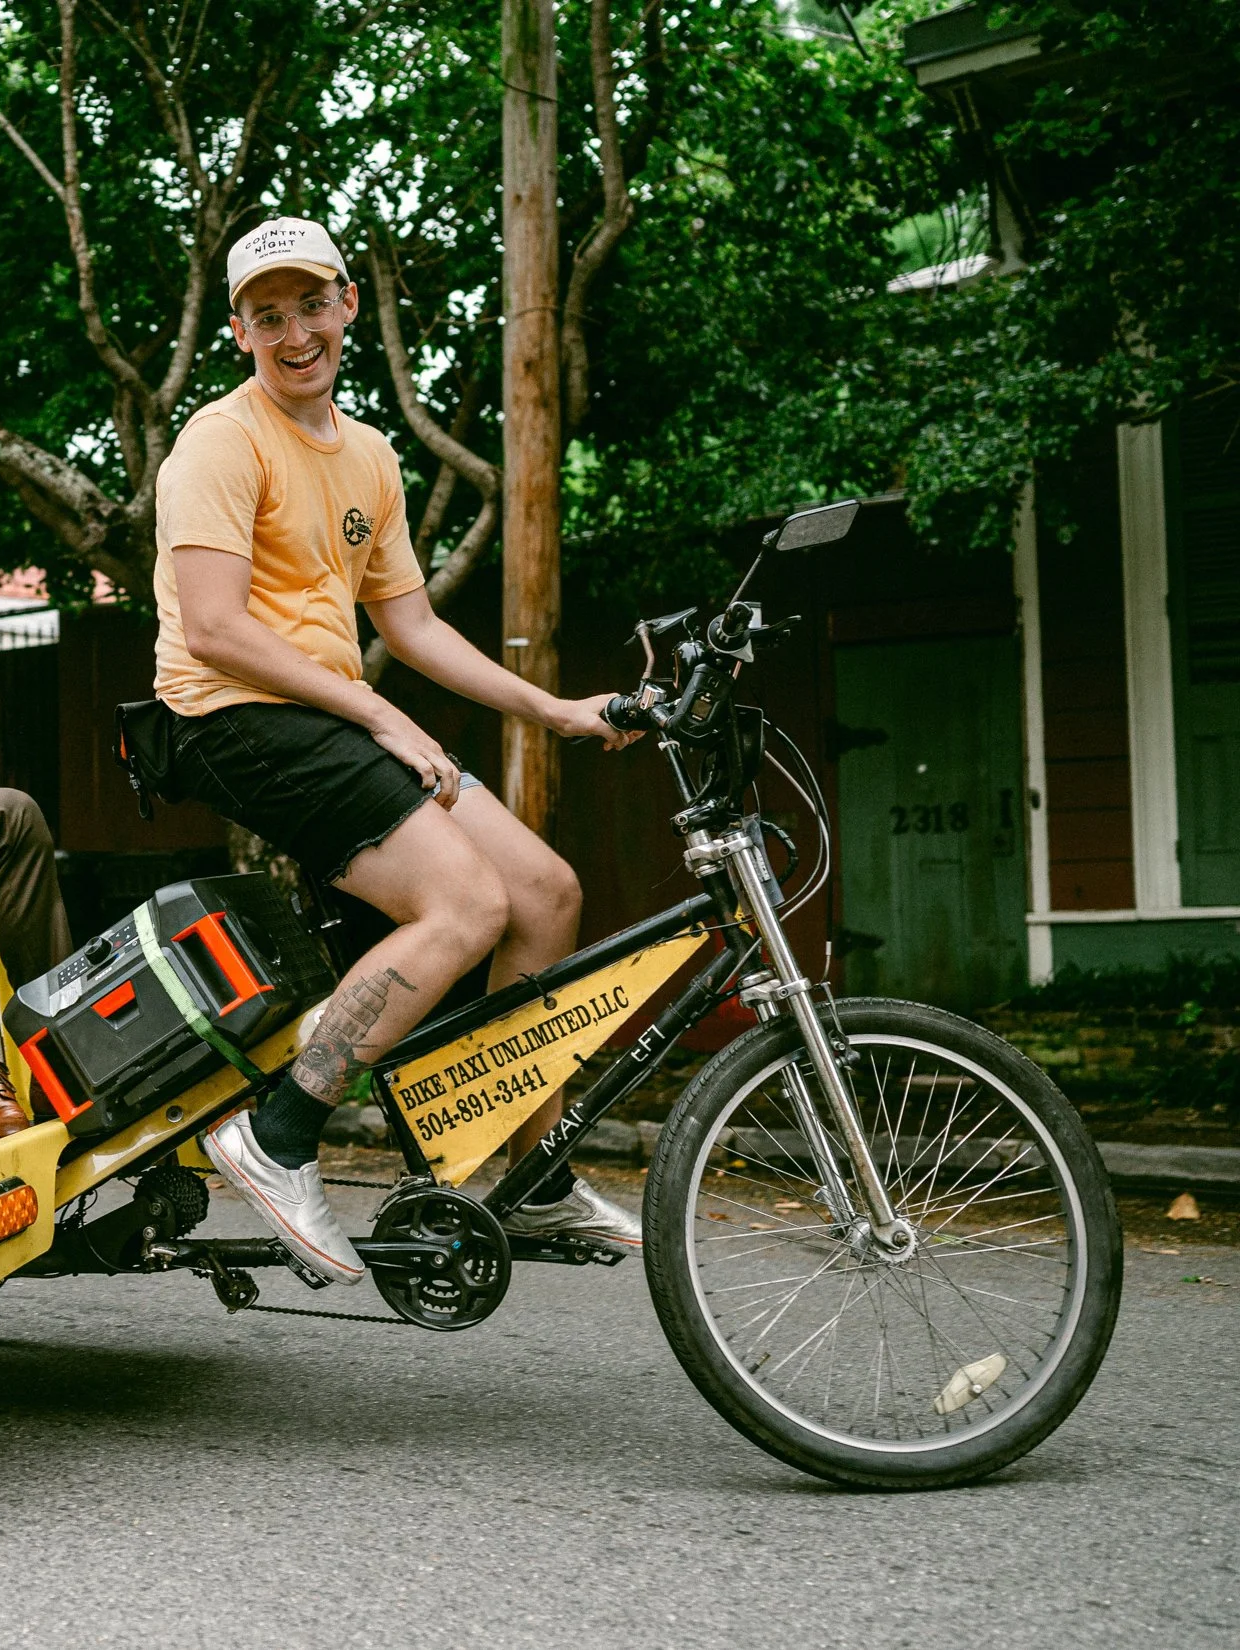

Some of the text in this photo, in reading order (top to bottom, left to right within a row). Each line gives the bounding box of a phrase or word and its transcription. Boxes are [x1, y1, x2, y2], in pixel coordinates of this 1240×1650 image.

[245, 229, 305, 250] COUNTRY
[255, 240, 296, 254] NIGHT
[889, 801, 970, 834] 2318
[398, 1070, 448, 1111] BIKE
[445, 1047, 492, 1090] TAXI
[415, 1063, 549, 1141] 504-891-3441
